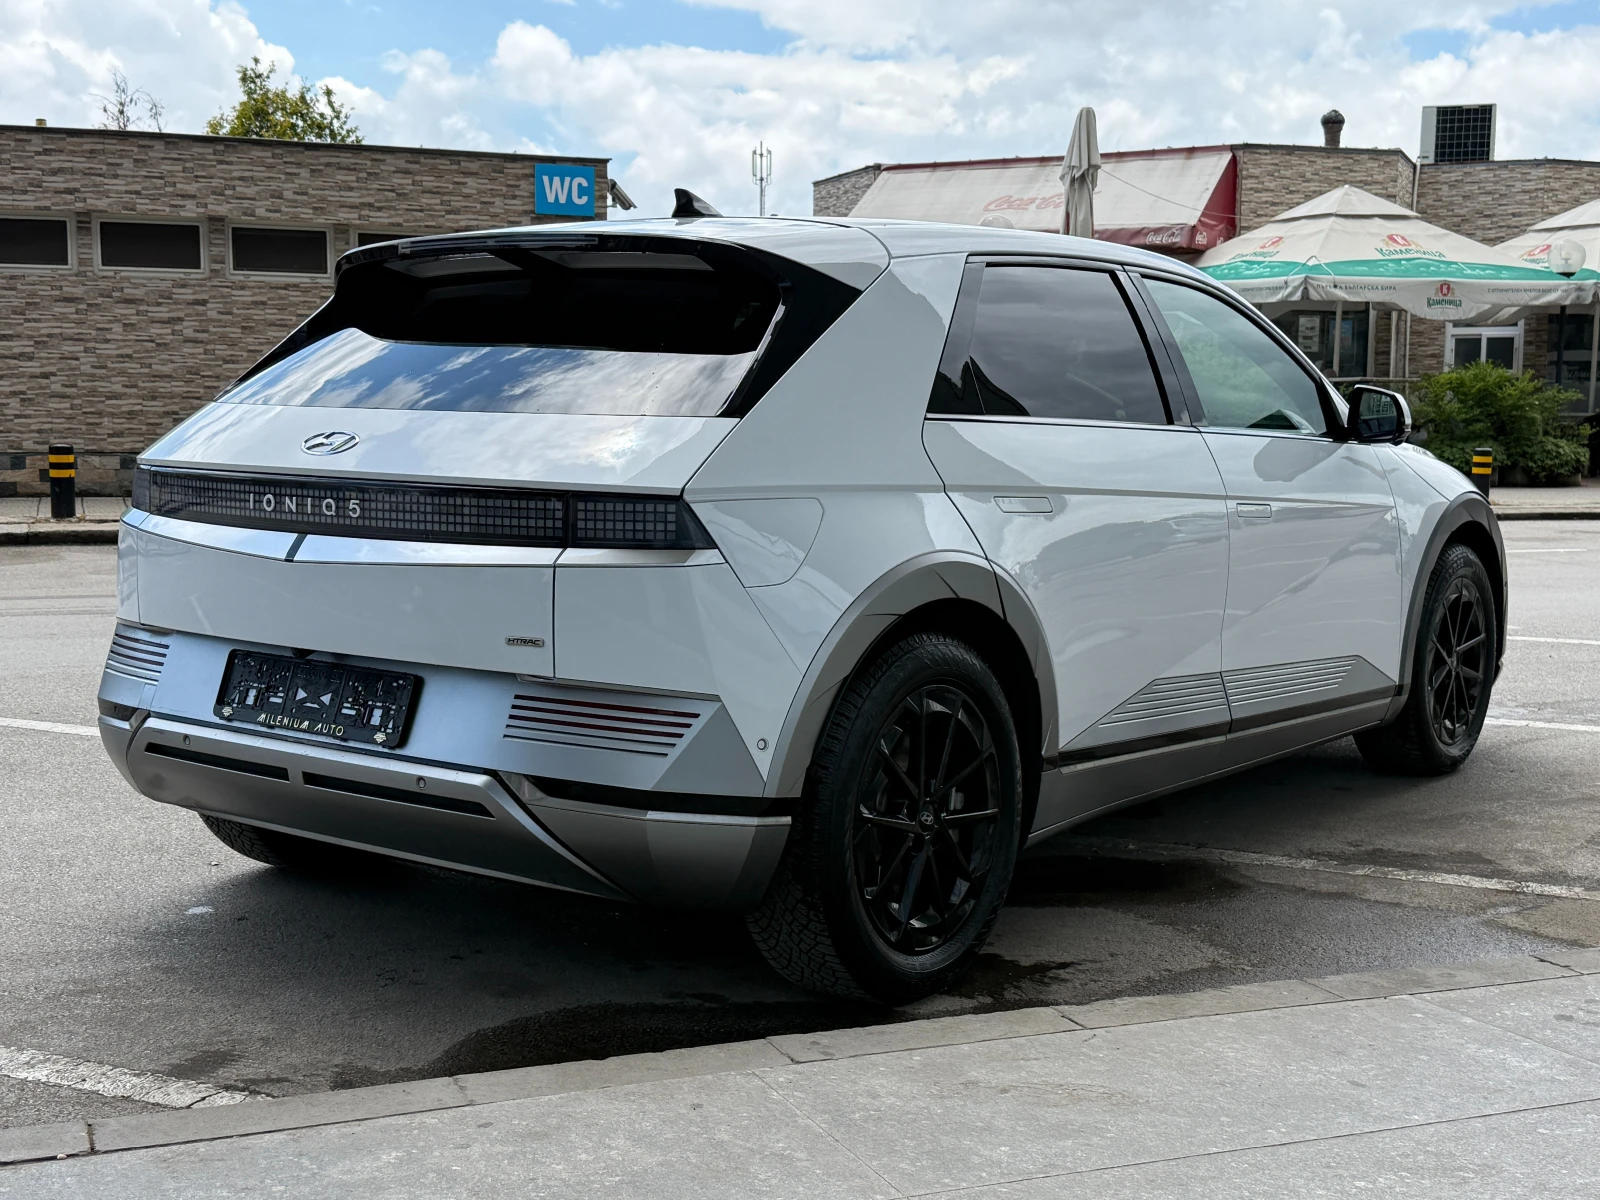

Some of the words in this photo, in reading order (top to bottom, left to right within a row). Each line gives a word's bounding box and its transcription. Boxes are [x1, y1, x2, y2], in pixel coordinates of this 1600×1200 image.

[542, 175, 589, 205] WC
[1374, 247, 1447, 259] Каменица
[1381, 284, 1397, 292] БИРА
[1427, 297, 1462, 308] Каменица
[249, 493, 336, 516] IONIQ
[349, 499, 361, 518] 5
[507, 637, 541, 646] HTRAC
[257, 712, 310, 730] MILENIUM
[314, 722, 344, 736] AUTO
